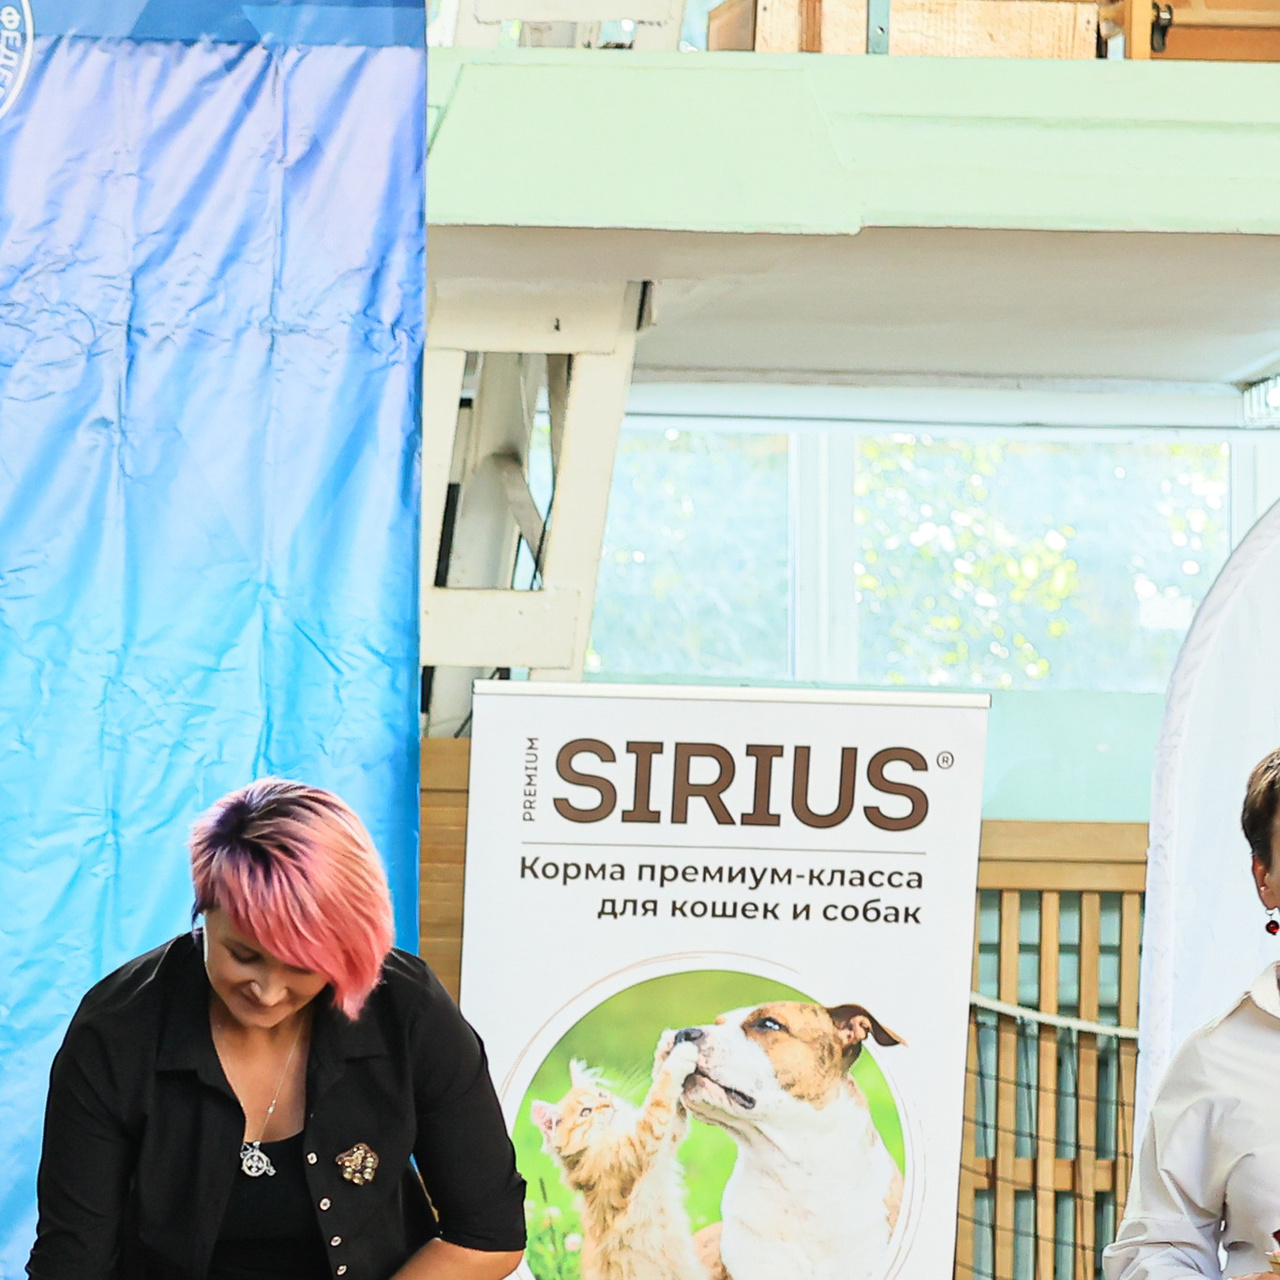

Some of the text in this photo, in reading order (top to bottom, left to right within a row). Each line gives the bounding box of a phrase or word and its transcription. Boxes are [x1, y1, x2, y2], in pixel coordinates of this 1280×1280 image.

[522, 736, 930, 832] PREMIUM SIRIUS
[520, 857, 925, 891] Корма премиум-класса
[598, 898, 922, 926] для кошек и собак
